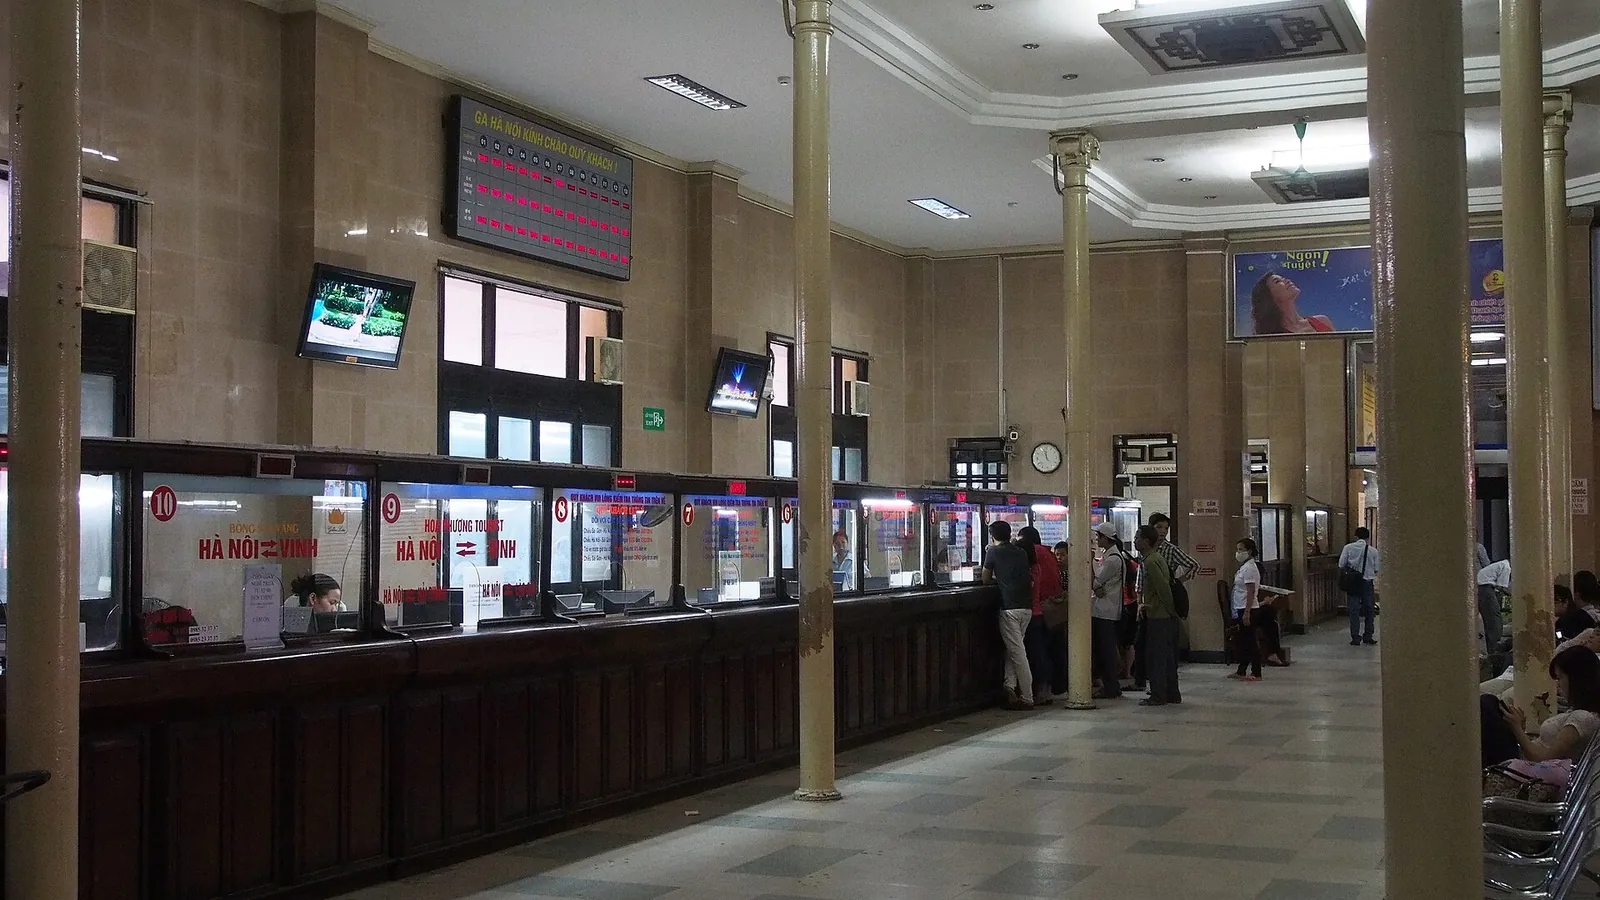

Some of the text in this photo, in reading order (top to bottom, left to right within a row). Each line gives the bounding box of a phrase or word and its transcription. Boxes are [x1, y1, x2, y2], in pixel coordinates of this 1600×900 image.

[475, 110, 488, 126] GA
[490, 115, 502, 132] HÀ
[505, 120, 521, 141] NỘI
[523, 127, 543, 146] KÍNH
[544, 136, 568, 154] CHÀO
[568, 145, 586, 160] QUÝ
[587, 151, 613, 172] KHÁCH
[1286, 251, 1321, 266] Ngon
[155, 490, 173, 516] 10
[387, 498, 396, 519] 9
[557, 501, 566, 518] 8
[685, 506, 691, 523] 7
[424, 519, 441, 533] HOA
[199, 533, 224, 559] HÀ
[280, 538, 318, 558] VINH
[396, 535, 415, 561] HÀ
[419, 535, 442, 567] NỘI
[383, 585, 392, 605] HÀ
[392, 585, 404, 607] NỘI
[482, 580, 490, 598] HÀ
[491, 580, 501, 600] NỘI
